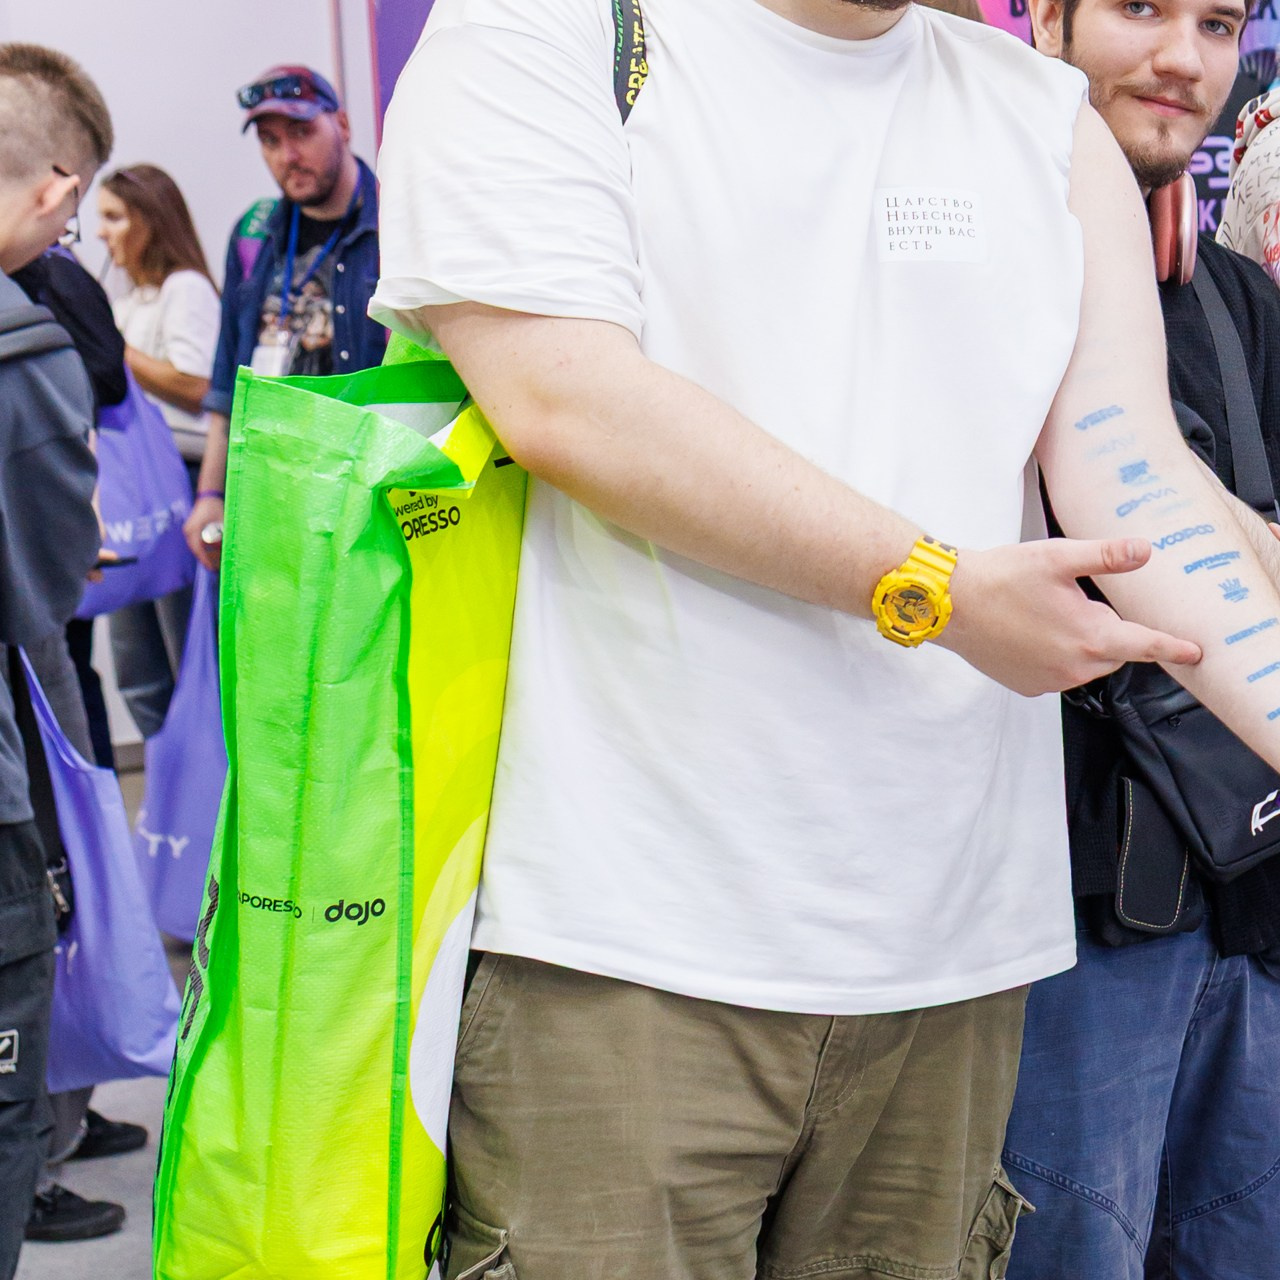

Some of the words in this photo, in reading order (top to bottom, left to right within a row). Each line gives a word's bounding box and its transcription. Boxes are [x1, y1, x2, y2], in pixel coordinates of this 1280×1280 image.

[886, 210, 974, 223] НЕБЕСНОЕ
[888, 225, 942, 236] ВНУТРЬ
[948, 226, 976, 238] ВАС
[889, 240, 933, 251] ЕСТЬ
[424, 494, 439, 509] by
[1152, 523, 1216, 550] VOOPOO
[324, 897, 386, 926] dojo
